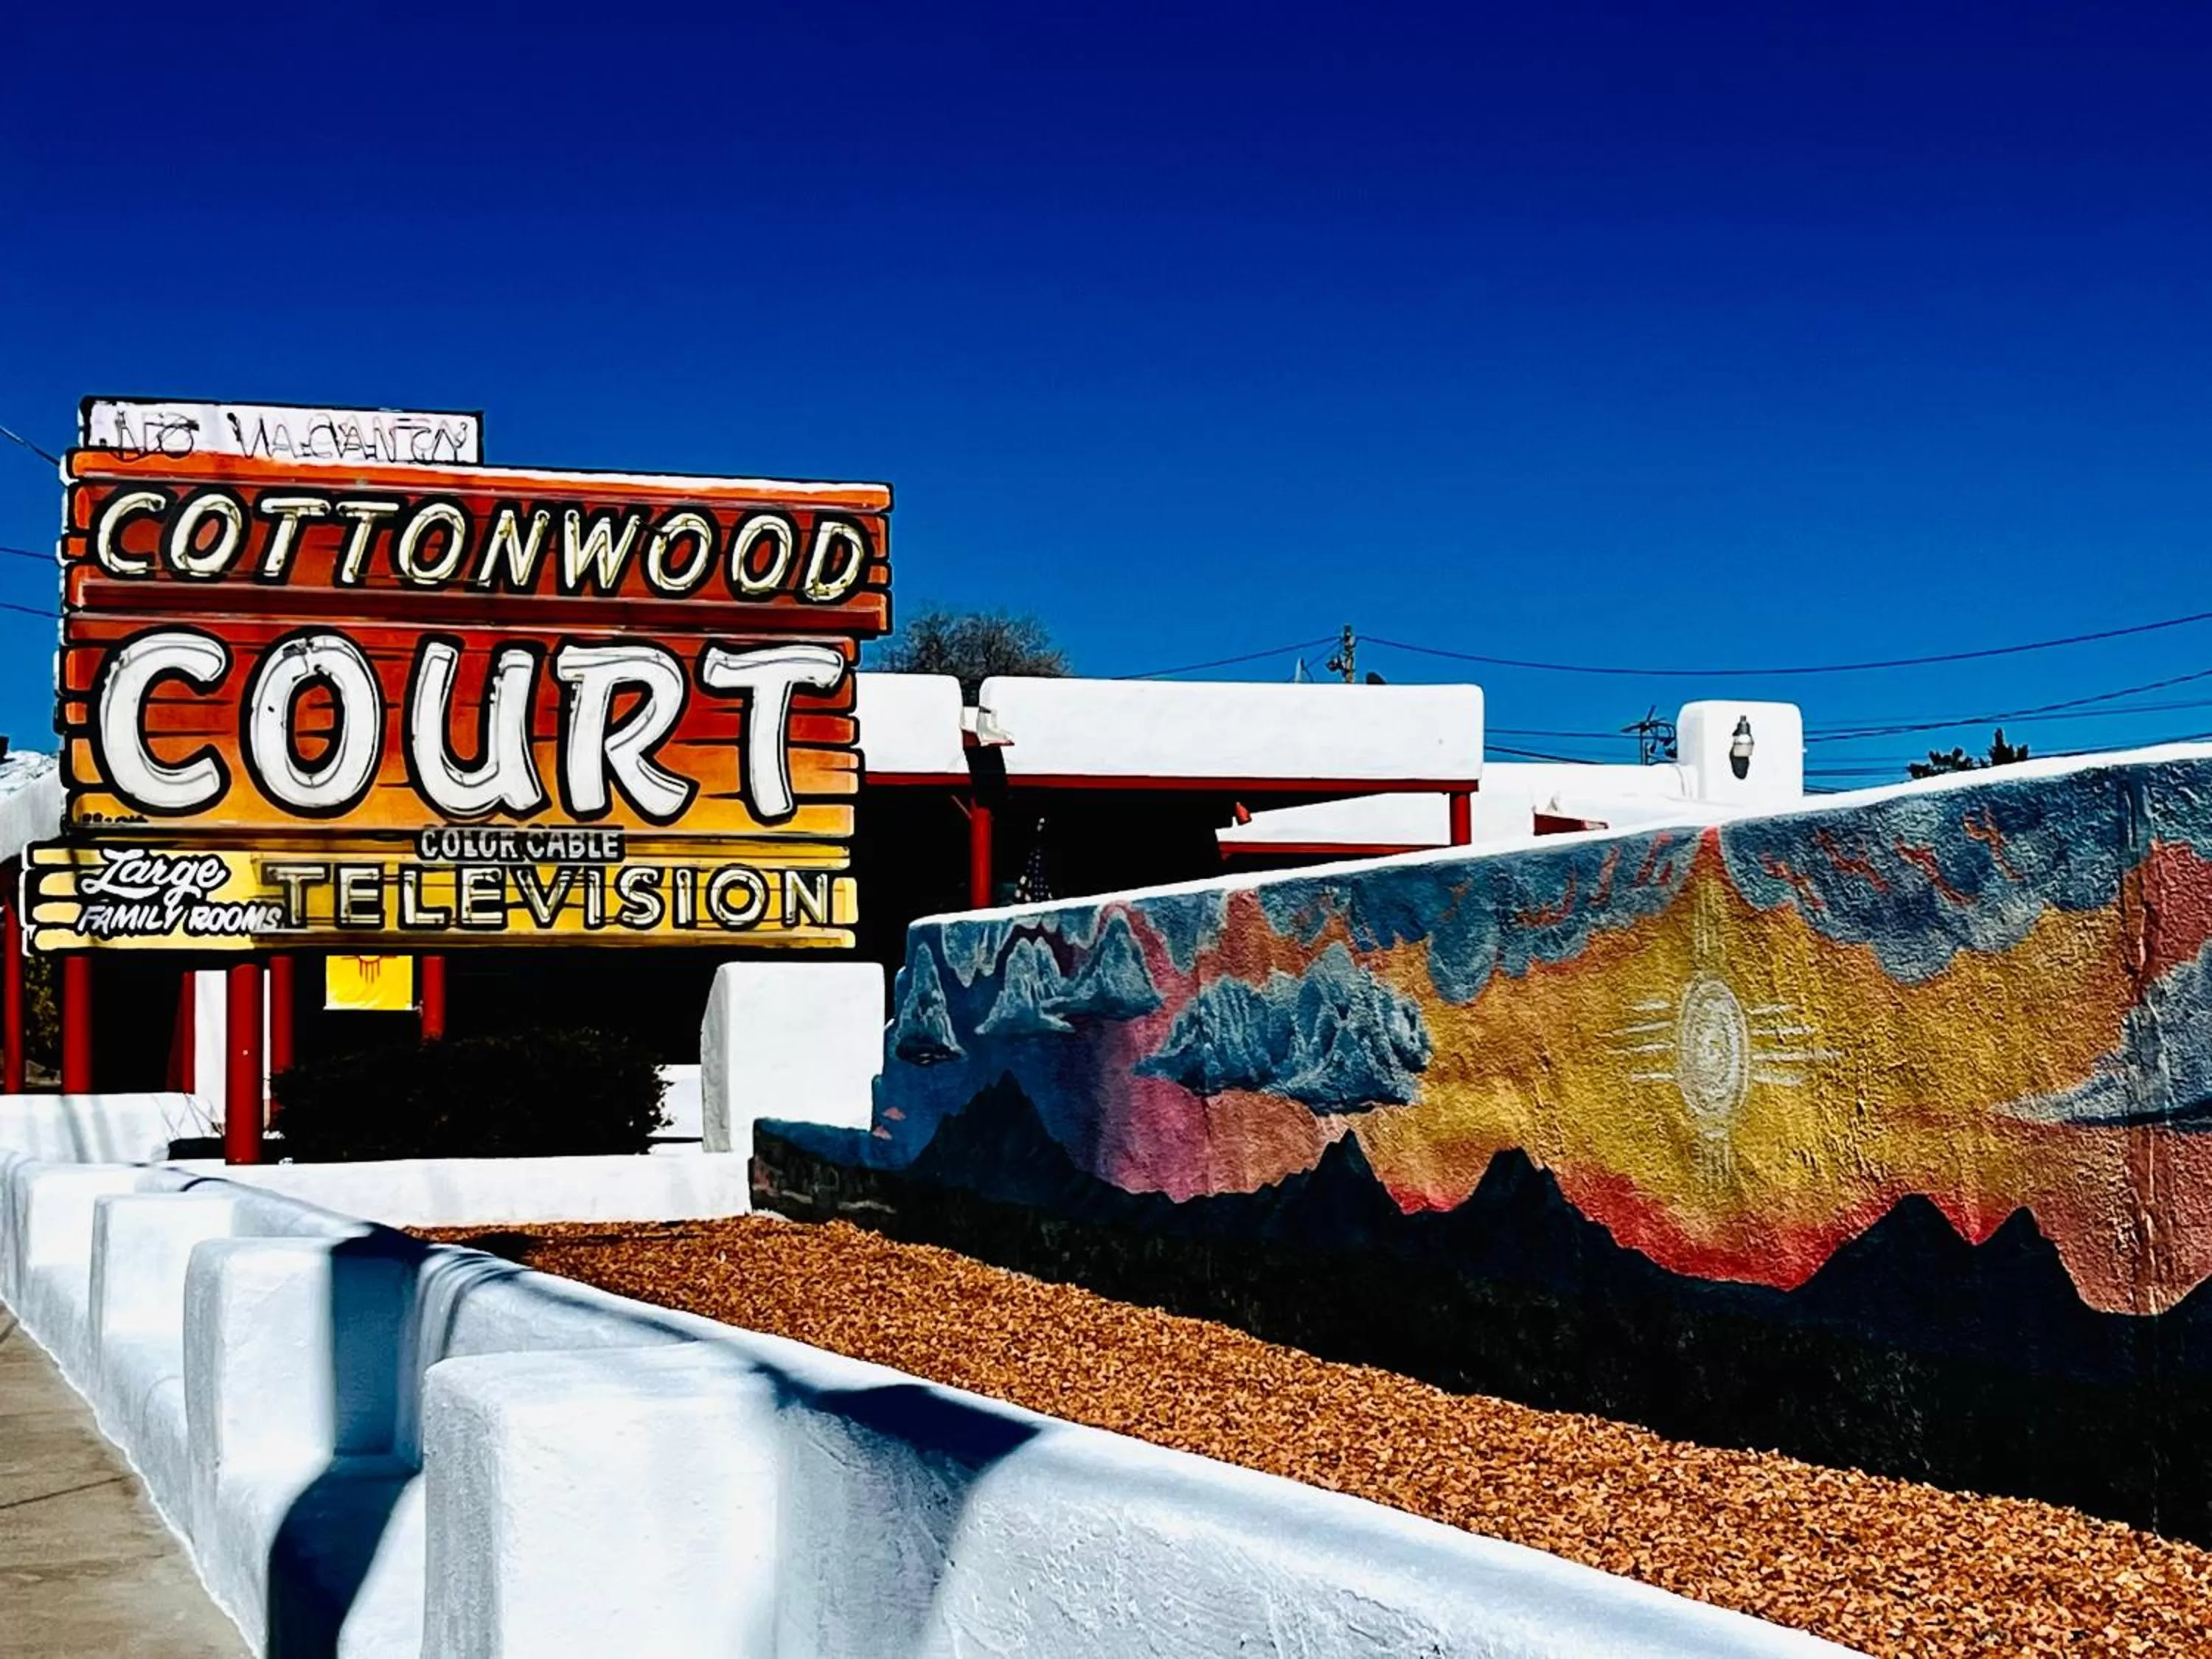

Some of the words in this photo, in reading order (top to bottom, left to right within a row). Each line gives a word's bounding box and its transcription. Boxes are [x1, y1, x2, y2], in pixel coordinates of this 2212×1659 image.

[97, 492, 864, 601] COTTONWOOD
[98, 633, 844, 817] COURT
[420, 830, 518, 858] COLOR
[525, 830, 621, 860] CABLE
[81, 848, 226, 907] Large
[266, 867, 829, 928] TELEVISION
[77, 905, 184, 936] FAMILY
